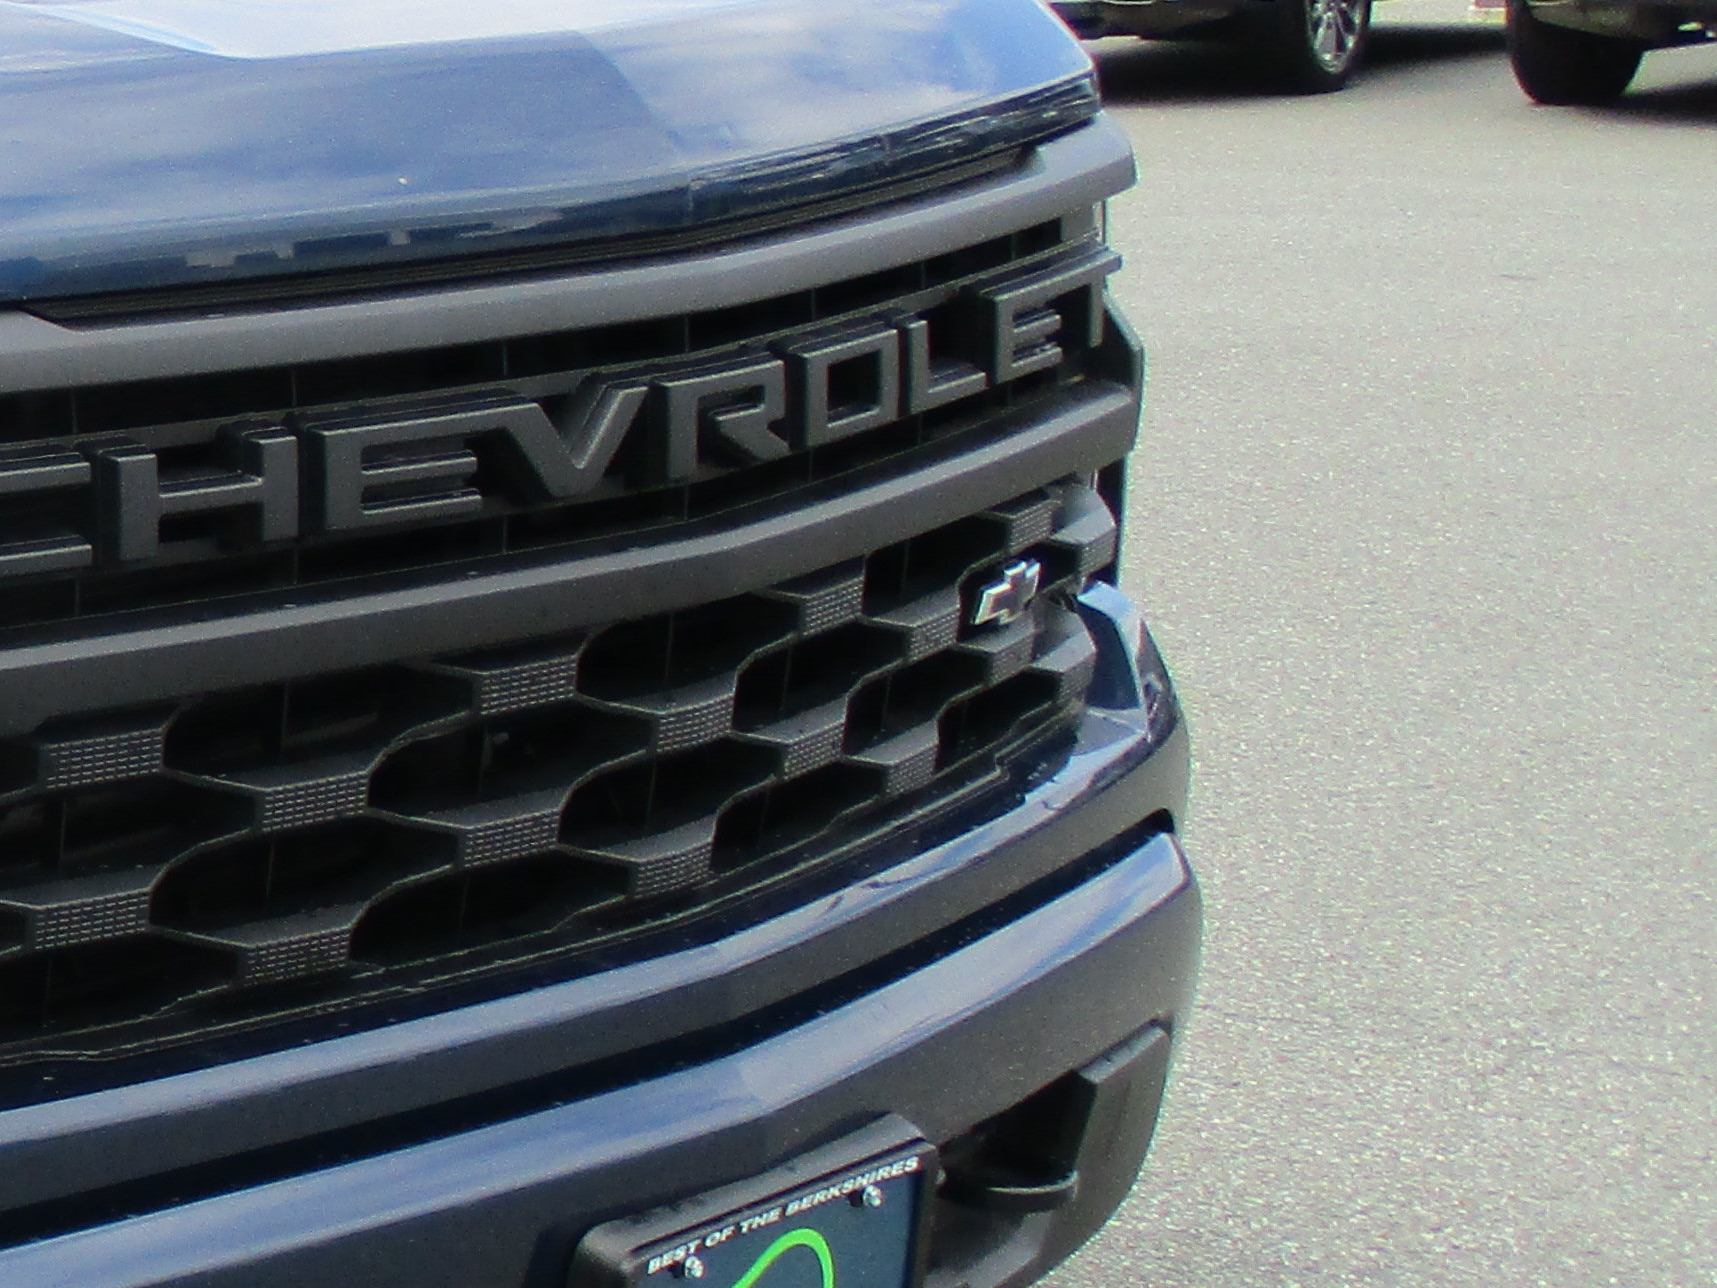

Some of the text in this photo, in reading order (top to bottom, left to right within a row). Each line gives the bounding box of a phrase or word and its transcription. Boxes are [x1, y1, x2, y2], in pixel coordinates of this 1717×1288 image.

[647, 1156, 921, 1275] BEST OF THE BERKSHIRES
